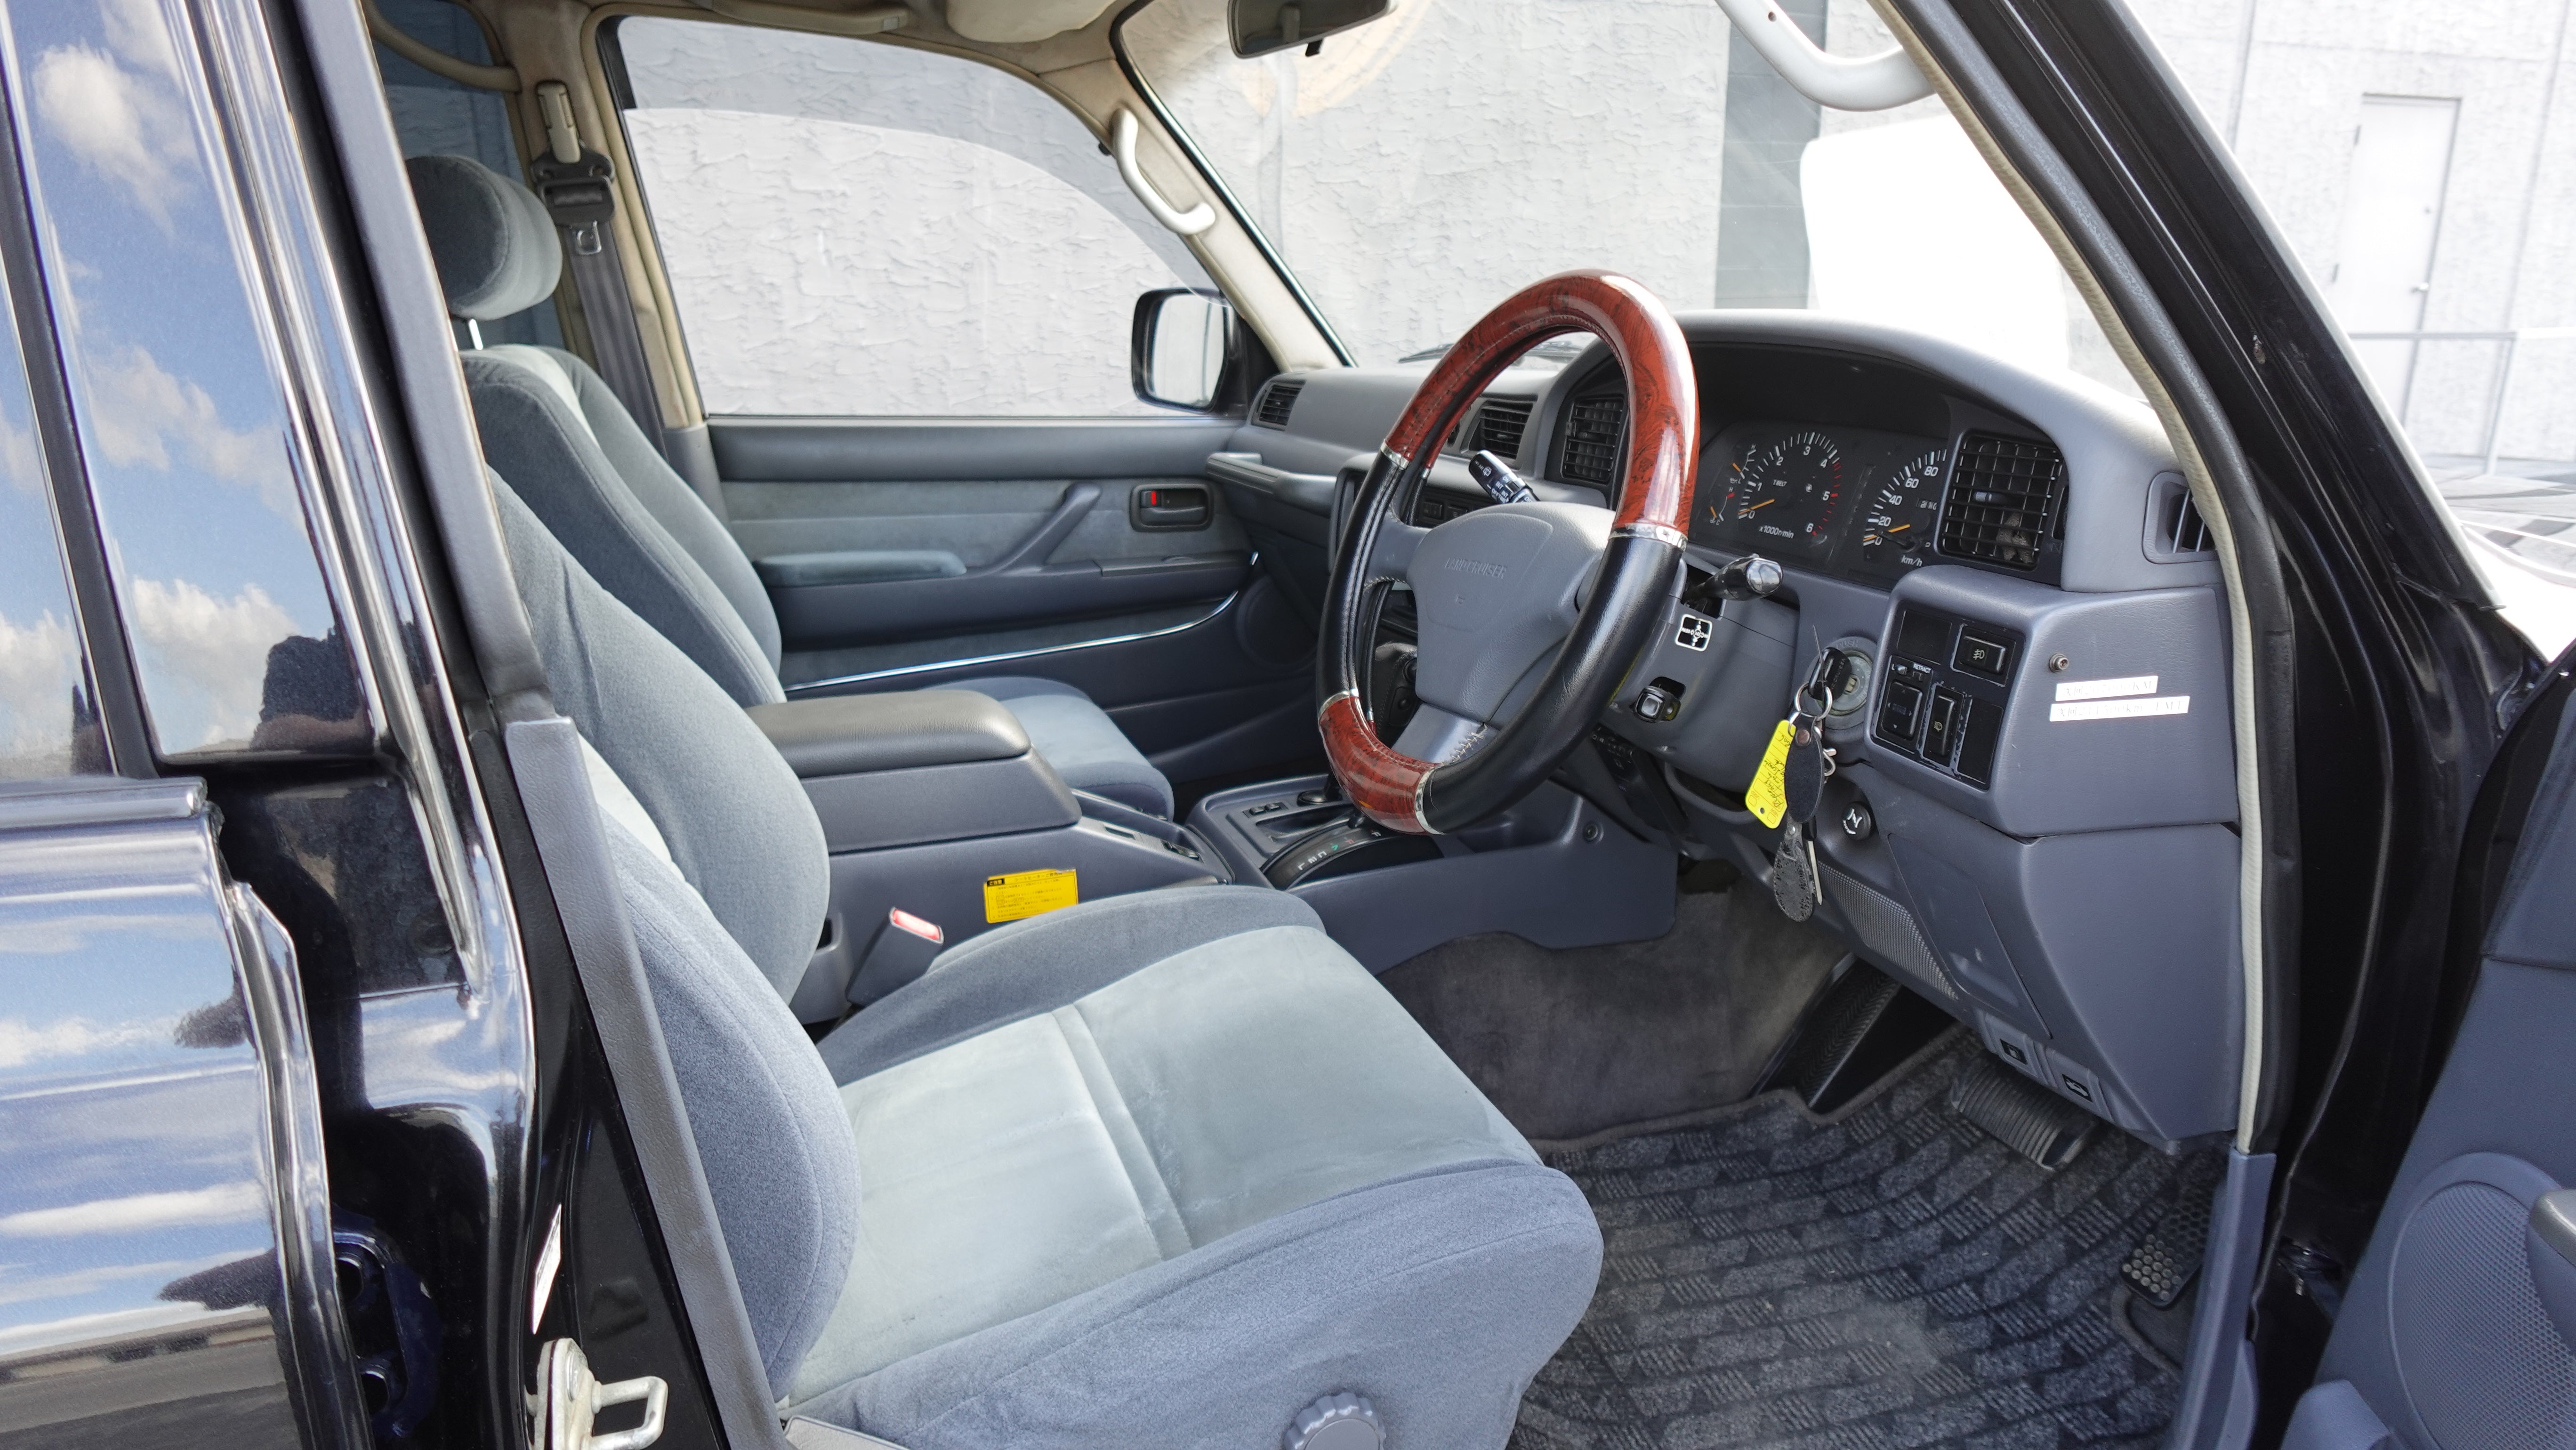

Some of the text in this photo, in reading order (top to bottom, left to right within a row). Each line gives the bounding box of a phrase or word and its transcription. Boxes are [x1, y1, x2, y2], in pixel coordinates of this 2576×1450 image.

[1803, 446, 1811, 456] 3
[1776, 456, 1784, 466] 2
[1820, 459, 1828, 468] 4
[1924, 466, 1939, 477] 80
[1758, 482, 1763, 491] 1
[1905, 478, 1919, 489] 60
[1822, 491, 1830, 501] 5
[1889, 495, 1902, 506] 40
[1748, 510, 1755, 519] 0
[1878, 516, 1892, 527] 20
[1806, 523, 1814, 533] 6
[1875, 537, 1883, 546] 0
[1901, 555, 1923, 567] km/h
[1444, 557, 1507, 580] LAND CRUISER
[1913, 663, 1932, 674] RETRACT
